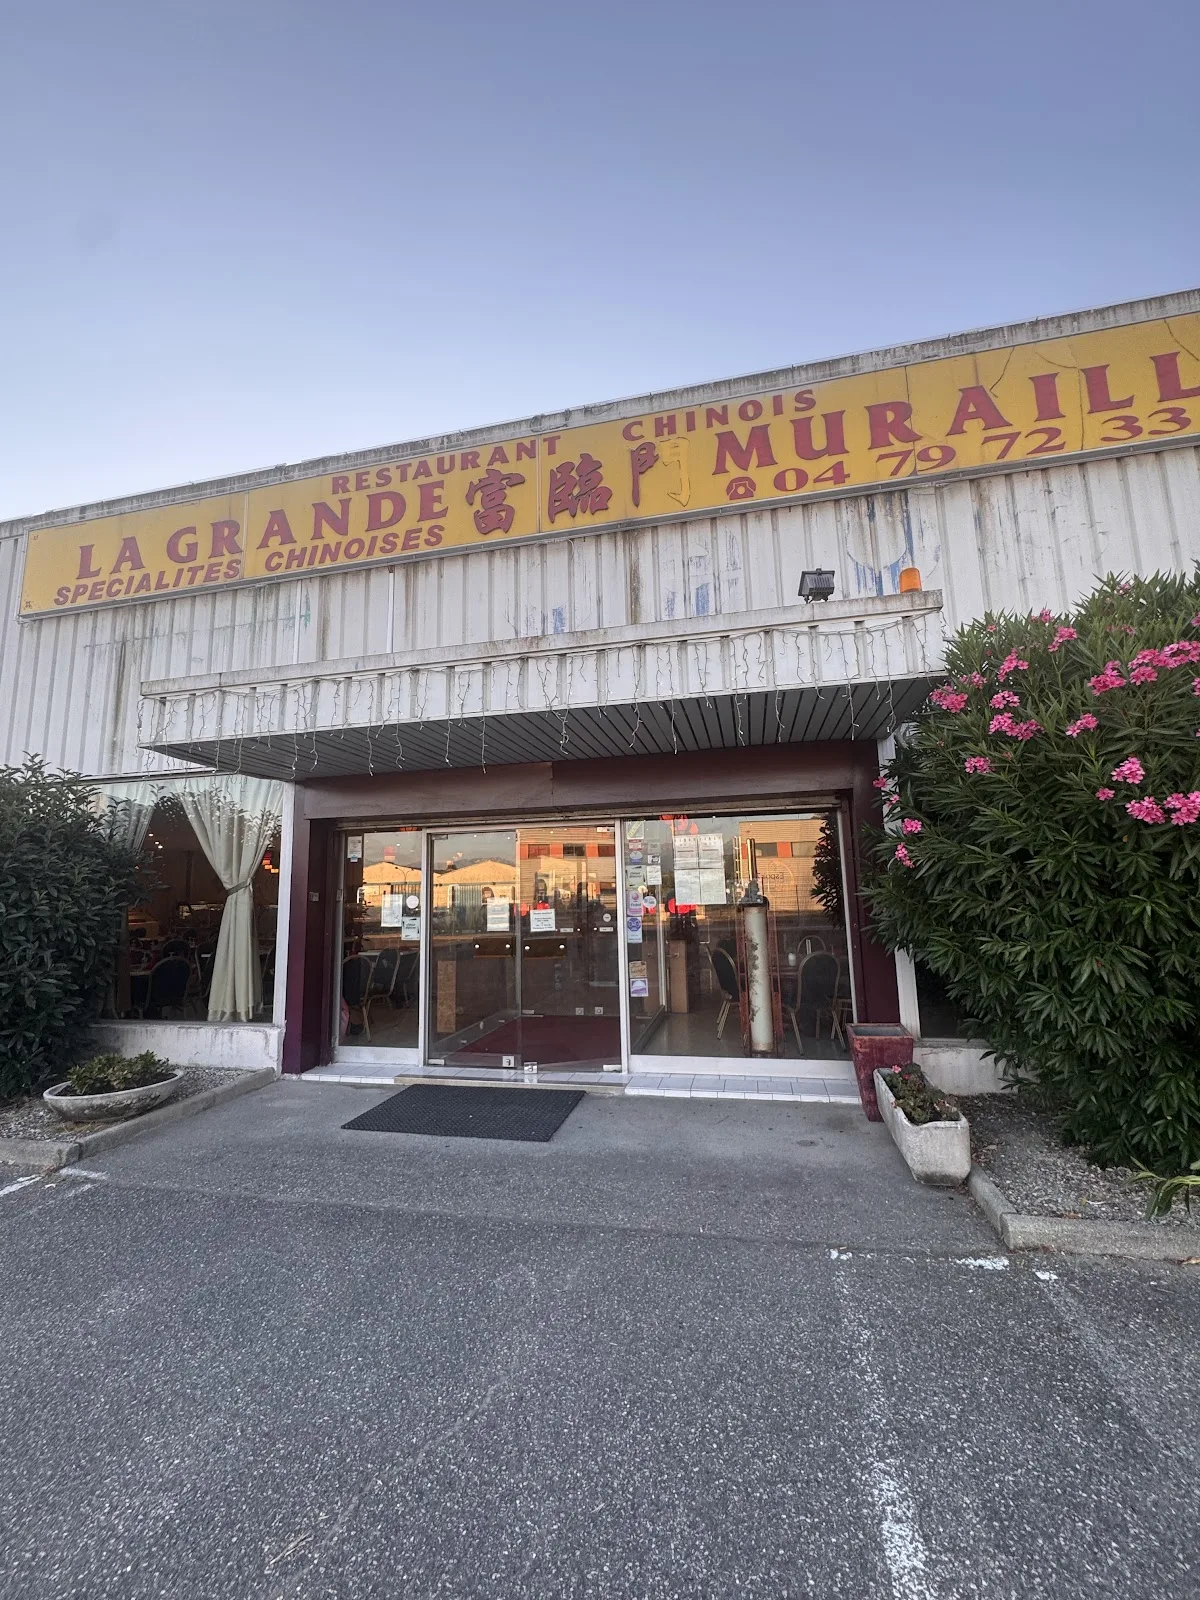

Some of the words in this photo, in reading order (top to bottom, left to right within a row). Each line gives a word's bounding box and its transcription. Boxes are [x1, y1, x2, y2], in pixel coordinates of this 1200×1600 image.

[76, 536, 147, 580] LA
[166, 480, 449, 564] GRANDE
[712, 351, 1200, 476] MURAILL
[332, 435, 562, 494] RESTAURANT
[622, 389, 817, 441] CHINOIS
[773, 461, 850, 492] 04
[876, 445, 956, 477] 79
[981, 427, 1066, 460] 72
[1100, 407, 1192, 442] 33
[54, 558, 241, 606] SPECIALITES
[265, 525, 444, 572] CHINOISES
